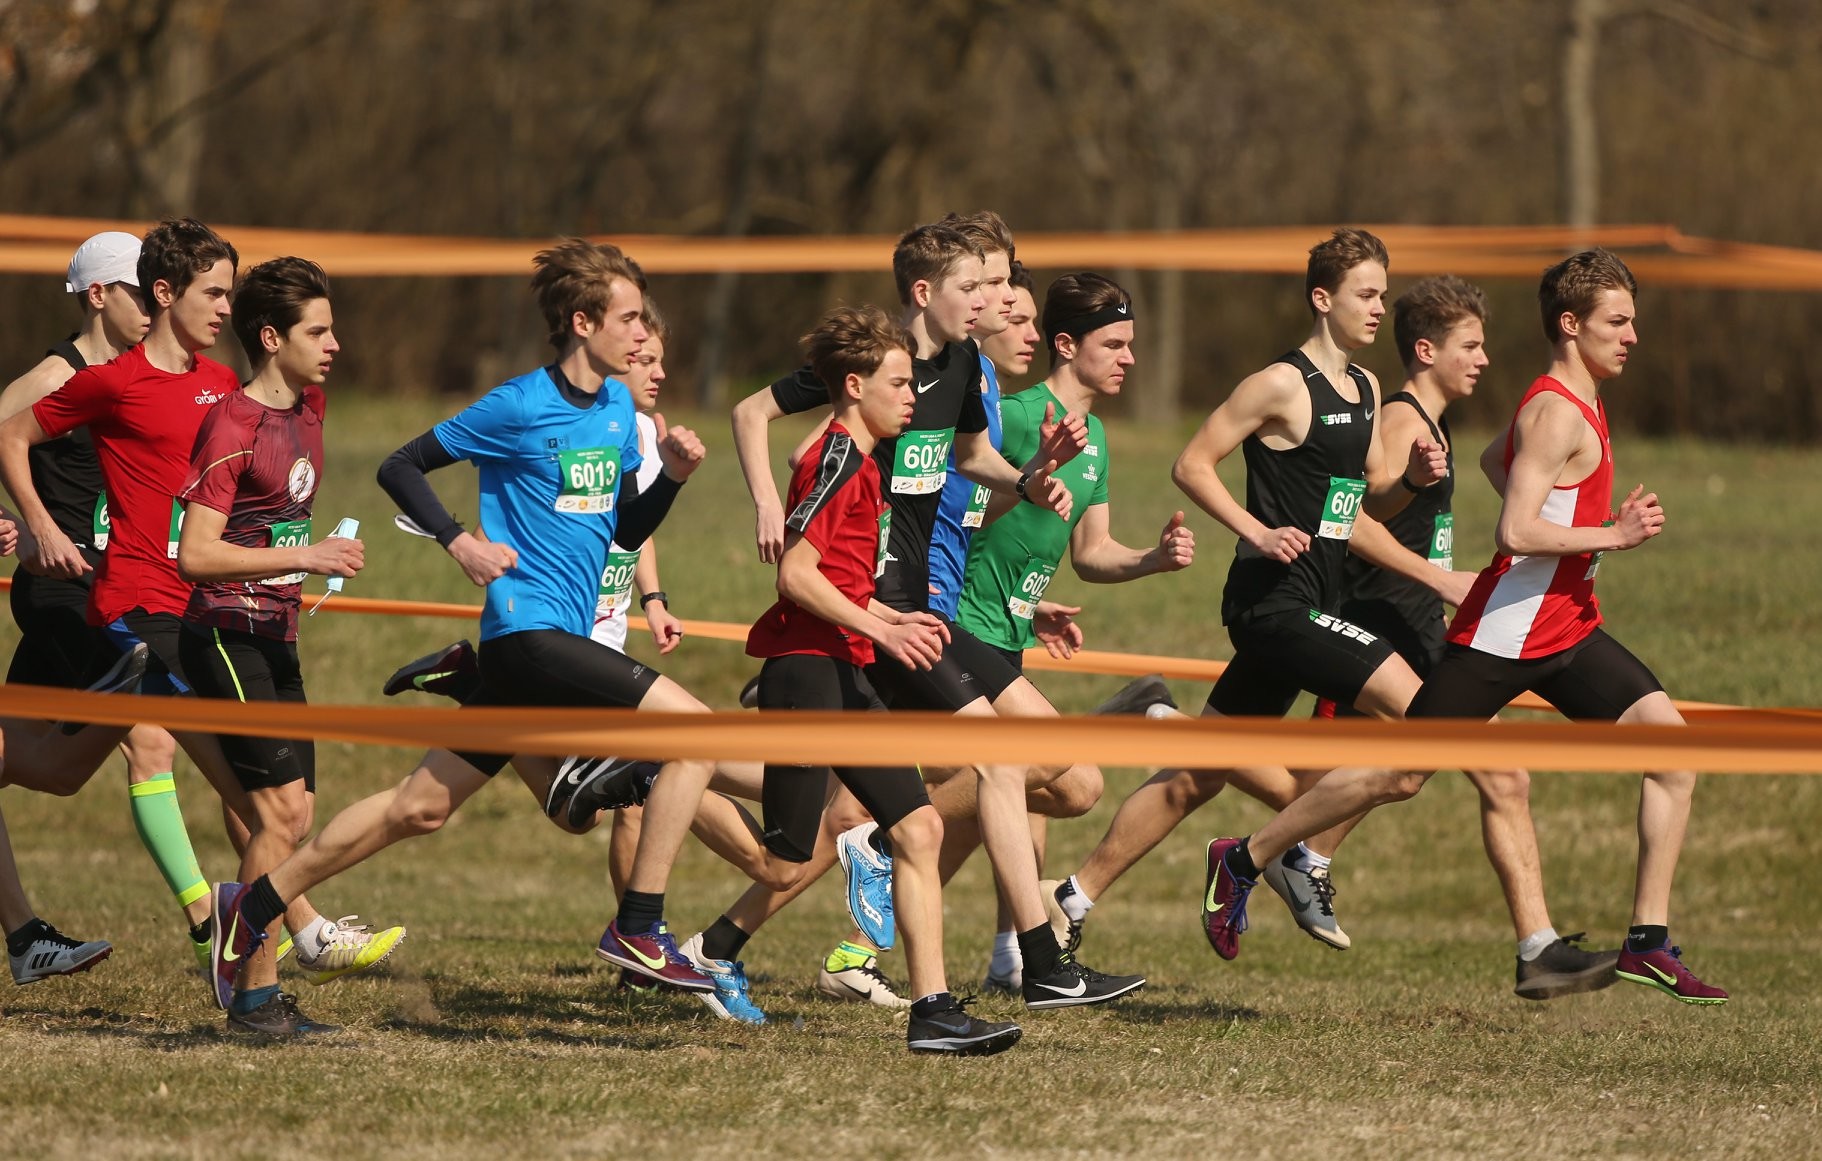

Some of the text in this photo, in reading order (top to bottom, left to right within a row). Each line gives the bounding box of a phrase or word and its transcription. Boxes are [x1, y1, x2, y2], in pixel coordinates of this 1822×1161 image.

[1327, 412, 1352, 426] SVSE
[903, 441, 949, 470] 6024
[570, 460, 616, 489] 6013
[974, 484, 993, 505] 60
[1331, 491, 1364, 517] 601
[601, 563, 638, 588] 602
[1022, 571, 1050, 598] 602
[1314, 612, 1378, 646] SVSE
